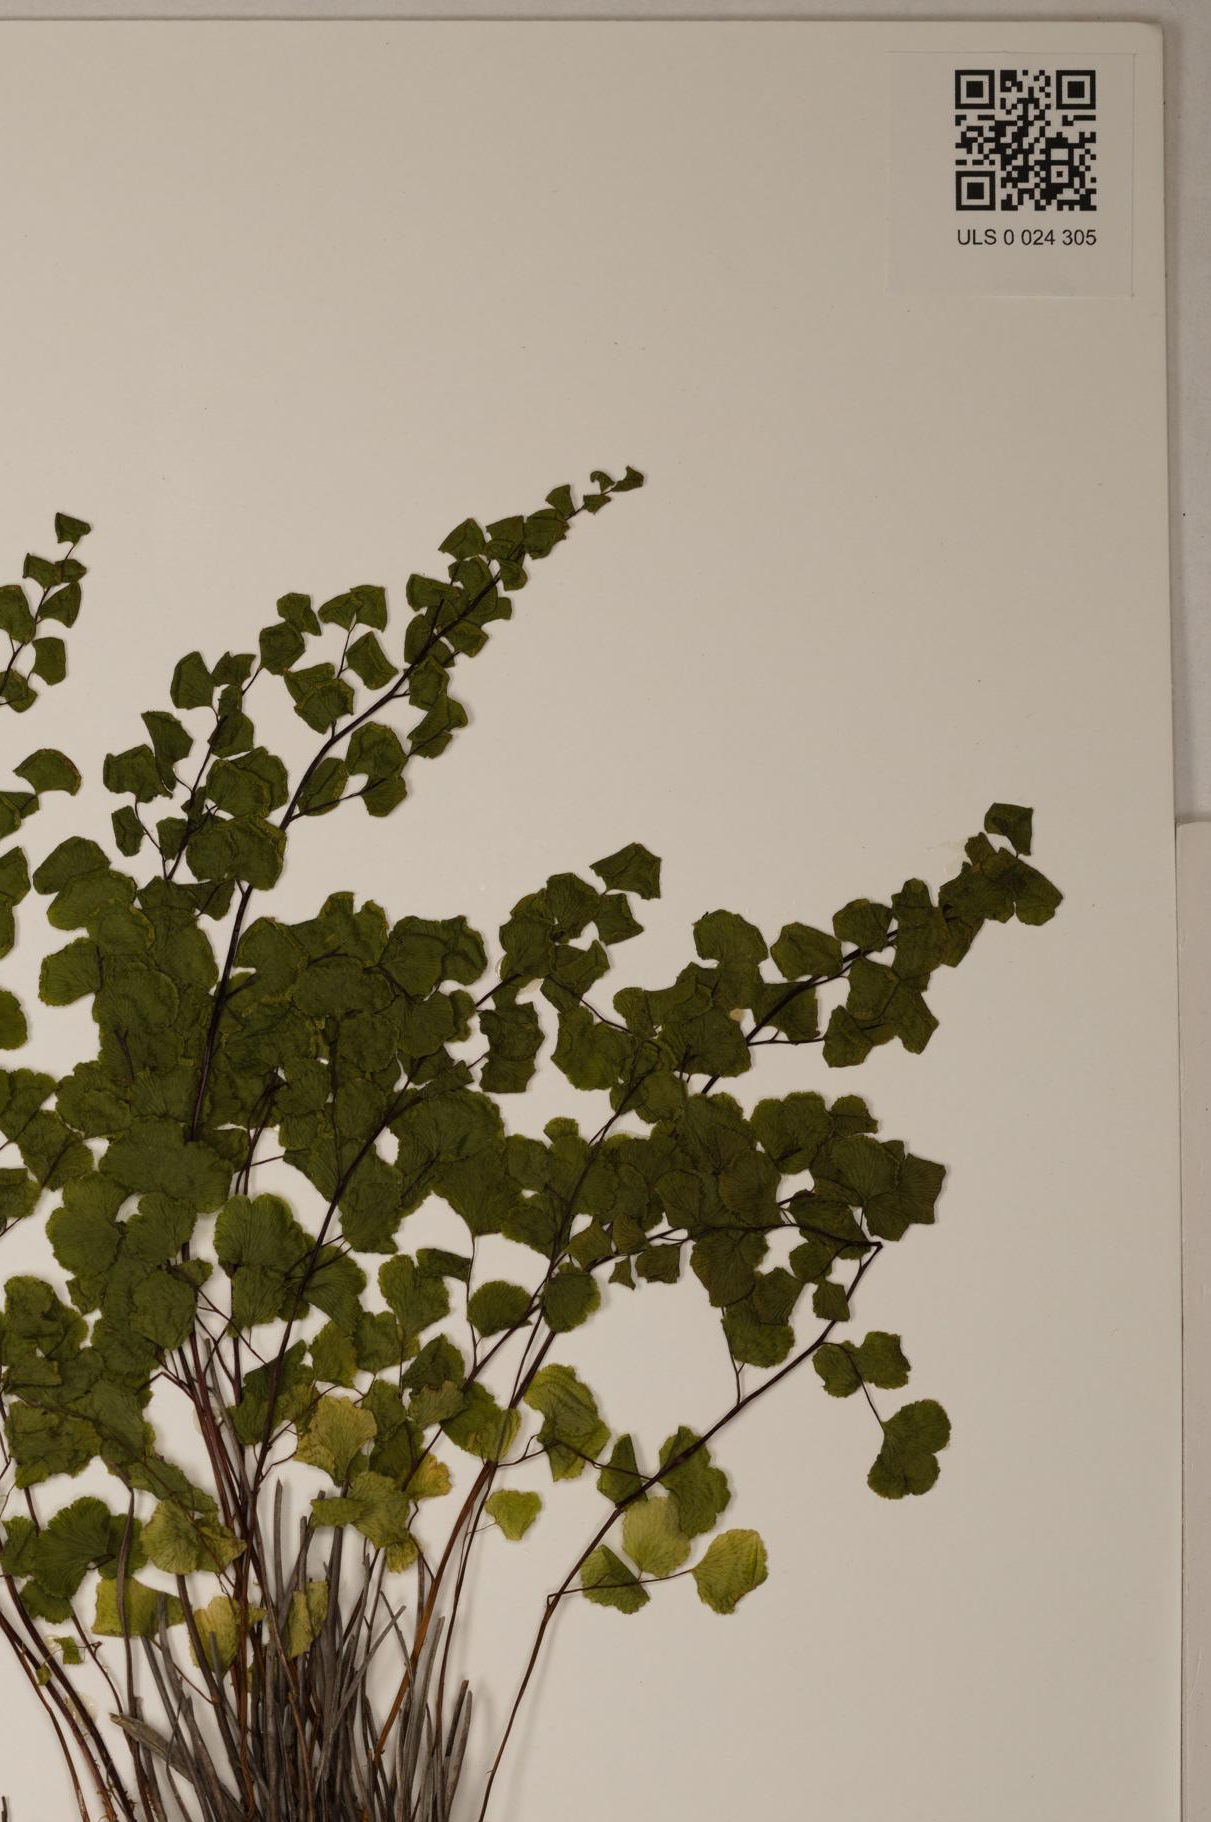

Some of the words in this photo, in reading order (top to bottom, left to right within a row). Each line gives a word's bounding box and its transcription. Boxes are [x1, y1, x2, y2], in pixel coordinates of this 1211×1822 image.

[957, 229, 997, 246] ULS
[1003, 229, 1015, 246] 0
[1021, 229, 1056, 246] 024
[1062, 229, 1097, 246] 305
